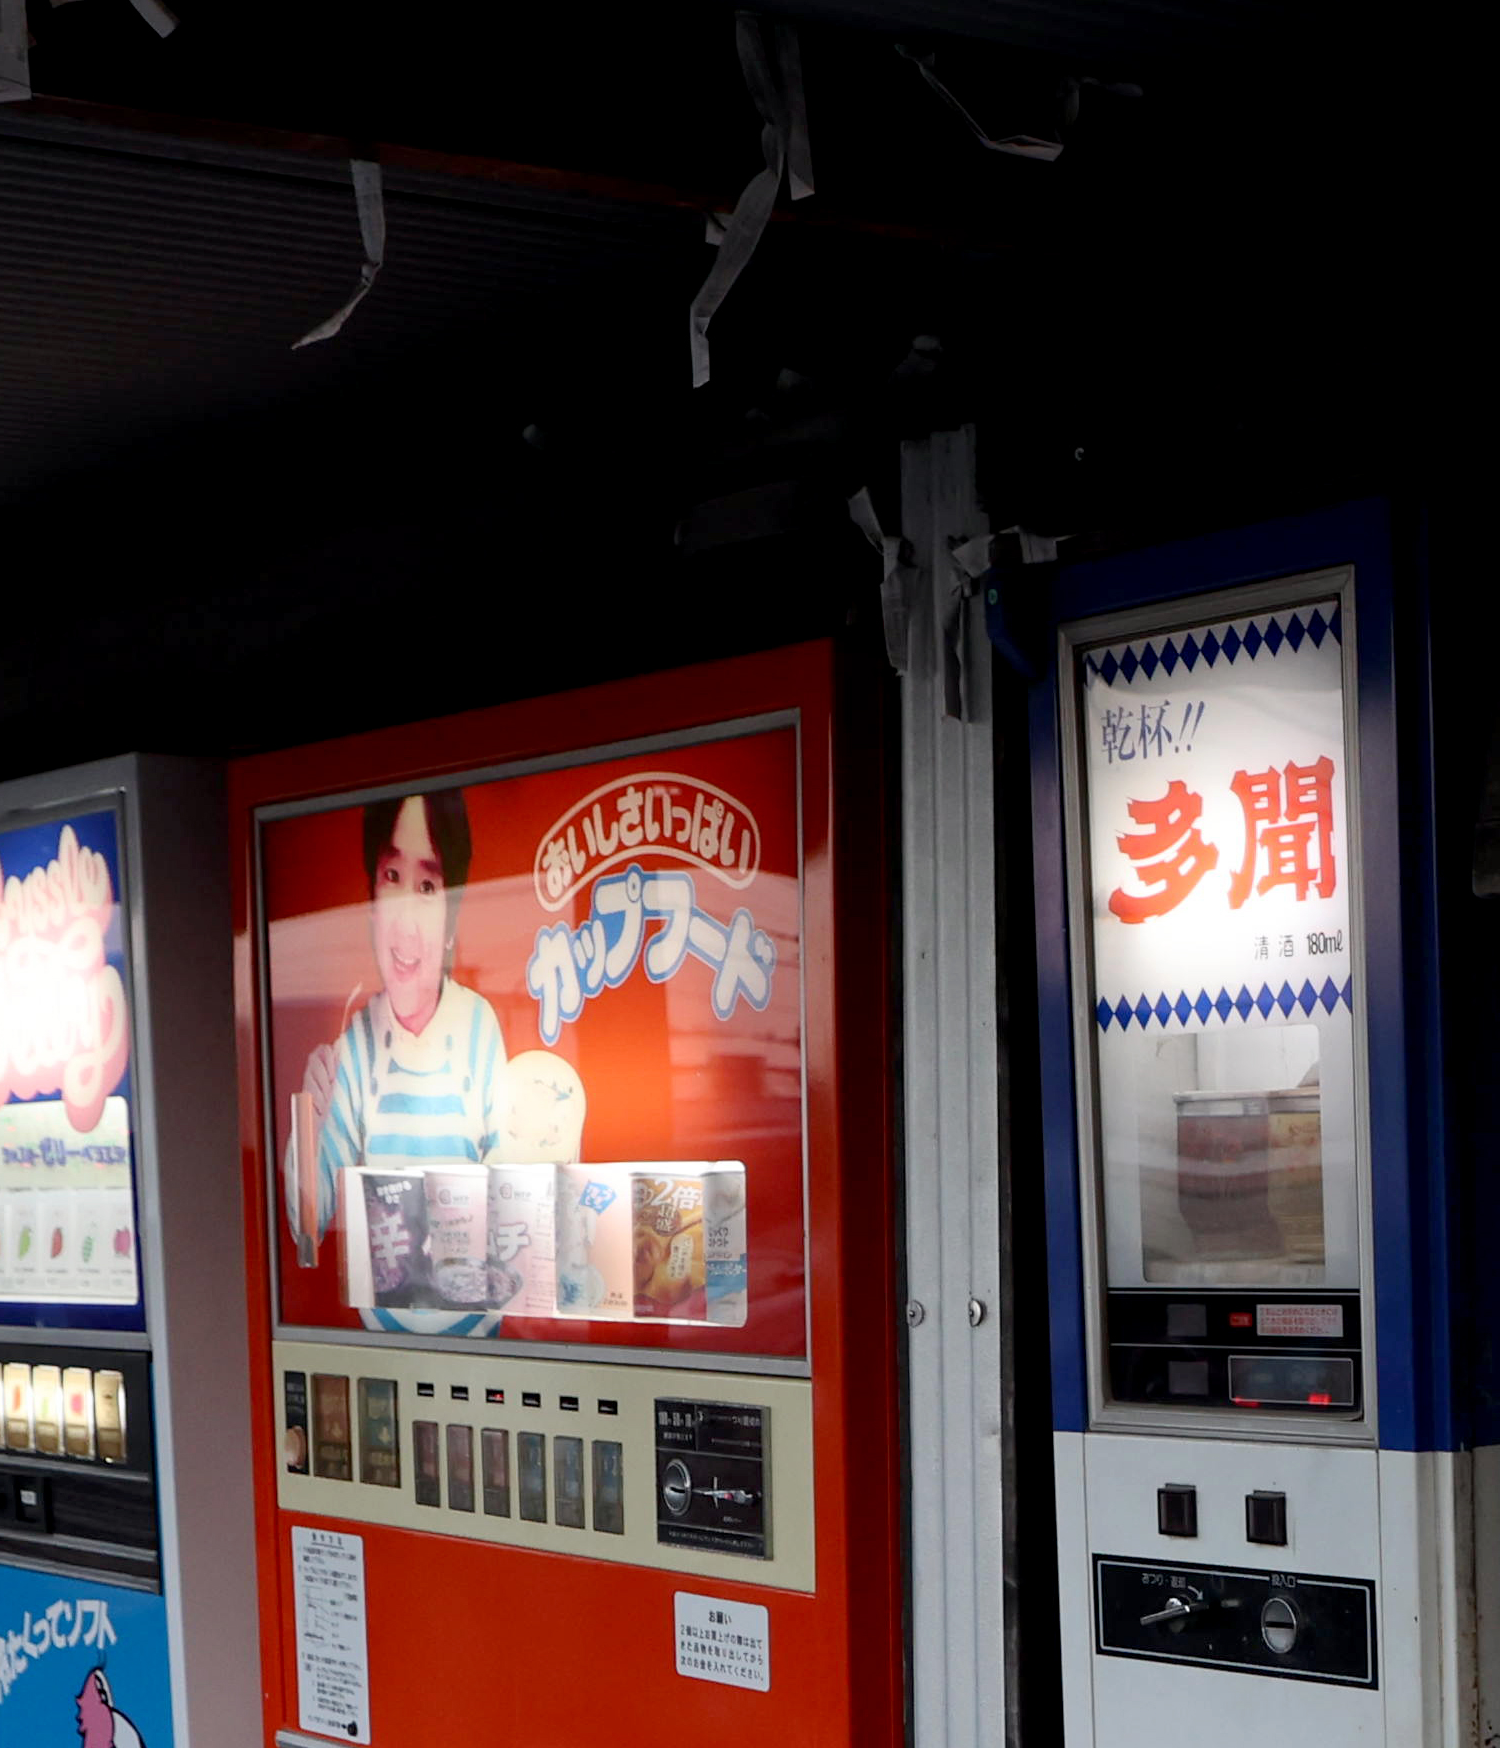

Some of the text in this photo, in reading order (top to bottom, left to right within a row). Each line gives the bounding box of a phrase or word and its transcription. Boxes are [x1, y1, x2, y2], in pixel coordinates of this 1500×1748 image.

[543, 786, 752, 898] おいしさいっぱい
[1108, 755, 1337, 924] 多聞
[528, 866, 775, 1042] カップフード
